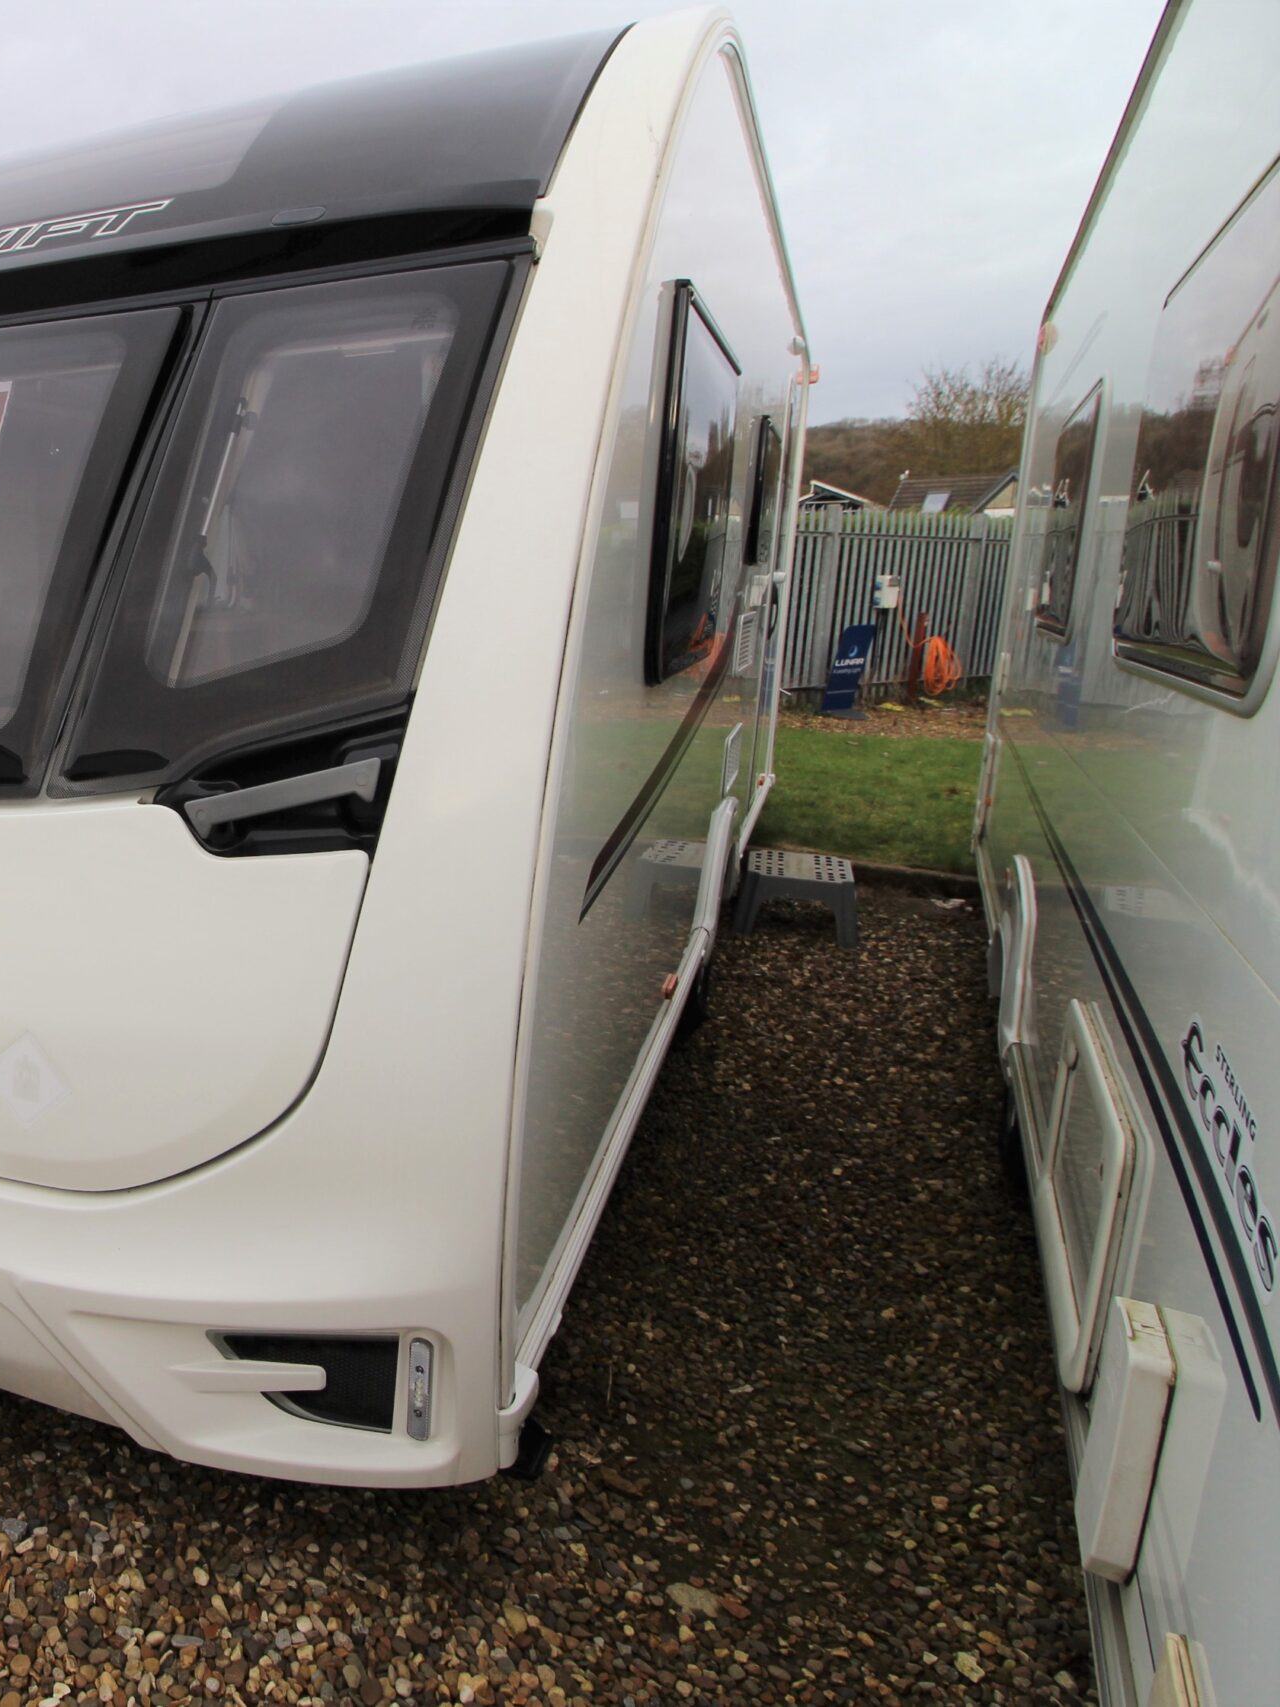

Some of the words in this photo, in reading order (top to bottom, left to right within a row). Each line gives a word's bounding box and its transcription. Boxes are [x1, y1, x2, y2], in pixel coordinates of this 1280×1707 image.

[834, 657, 864, 667] LUNAR
[1215, 1044, 1258, 1142] STERLING
[1181, 1021, 1279, 1292] Eccles
